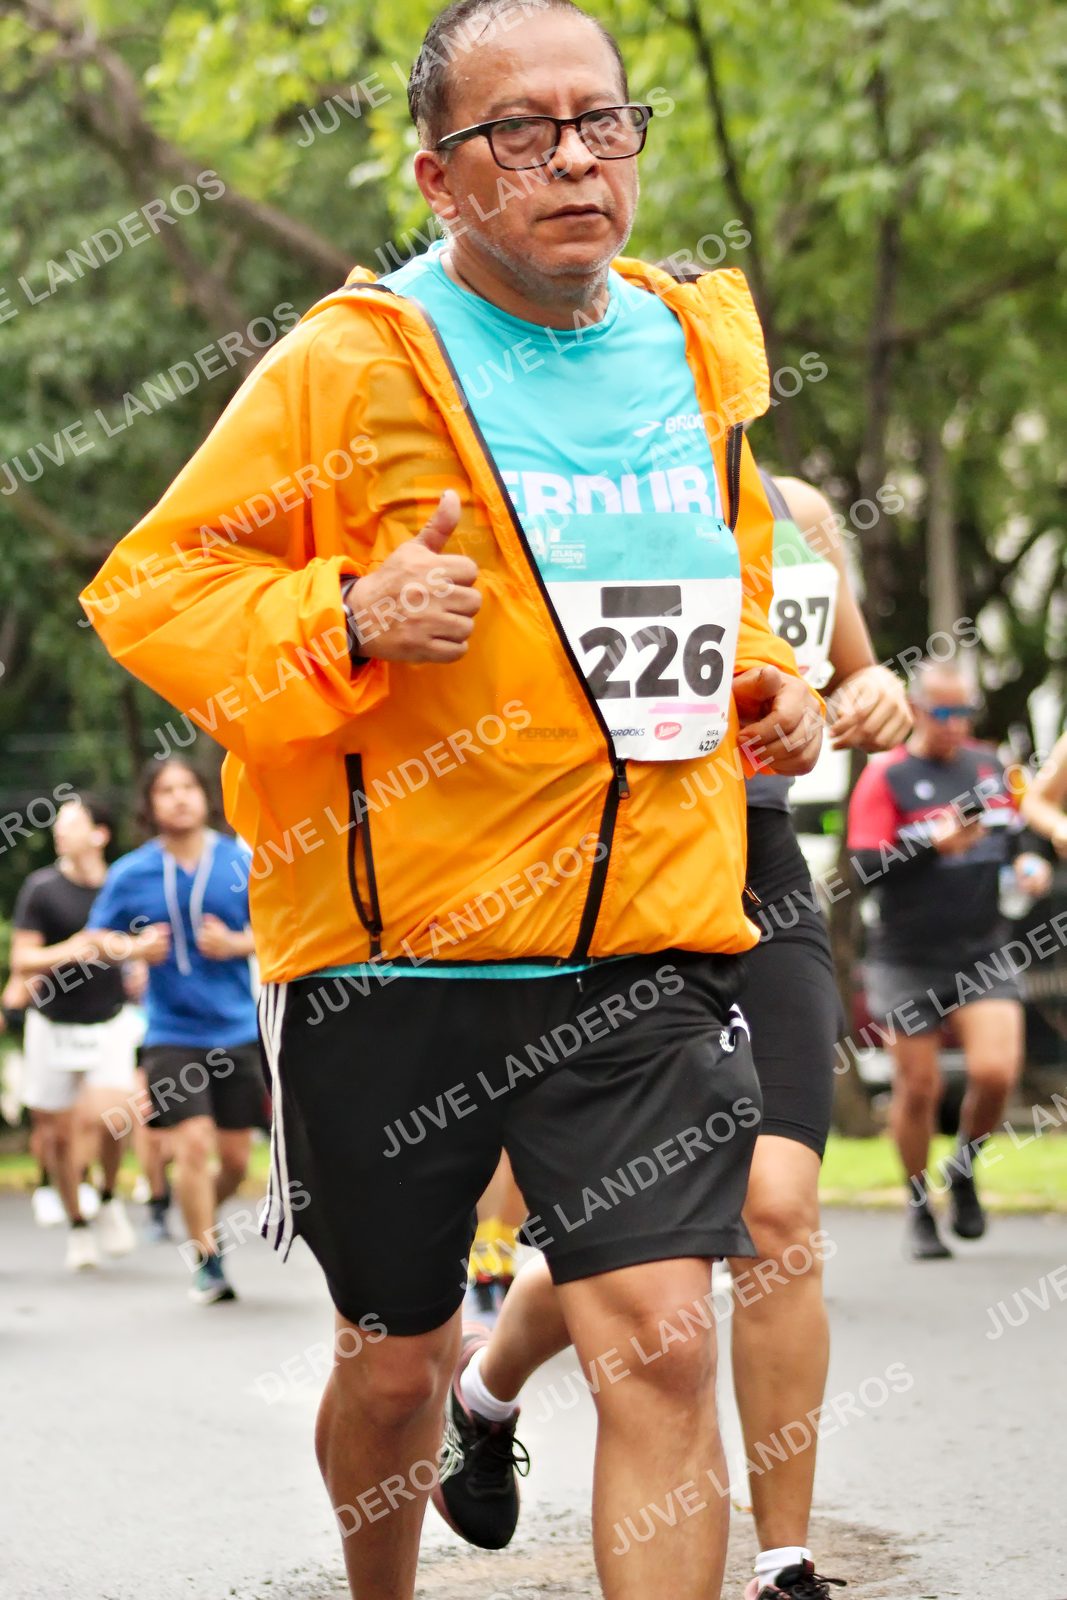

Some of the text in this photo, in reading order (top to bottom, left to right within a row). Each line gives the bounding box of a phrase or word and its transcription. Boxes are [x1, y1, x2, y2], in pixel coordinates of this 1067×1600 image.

[776, 597, 829, 647] 87
[578, 624, 726, 698] 226
[611, 728, 645, 737] BROOKS
